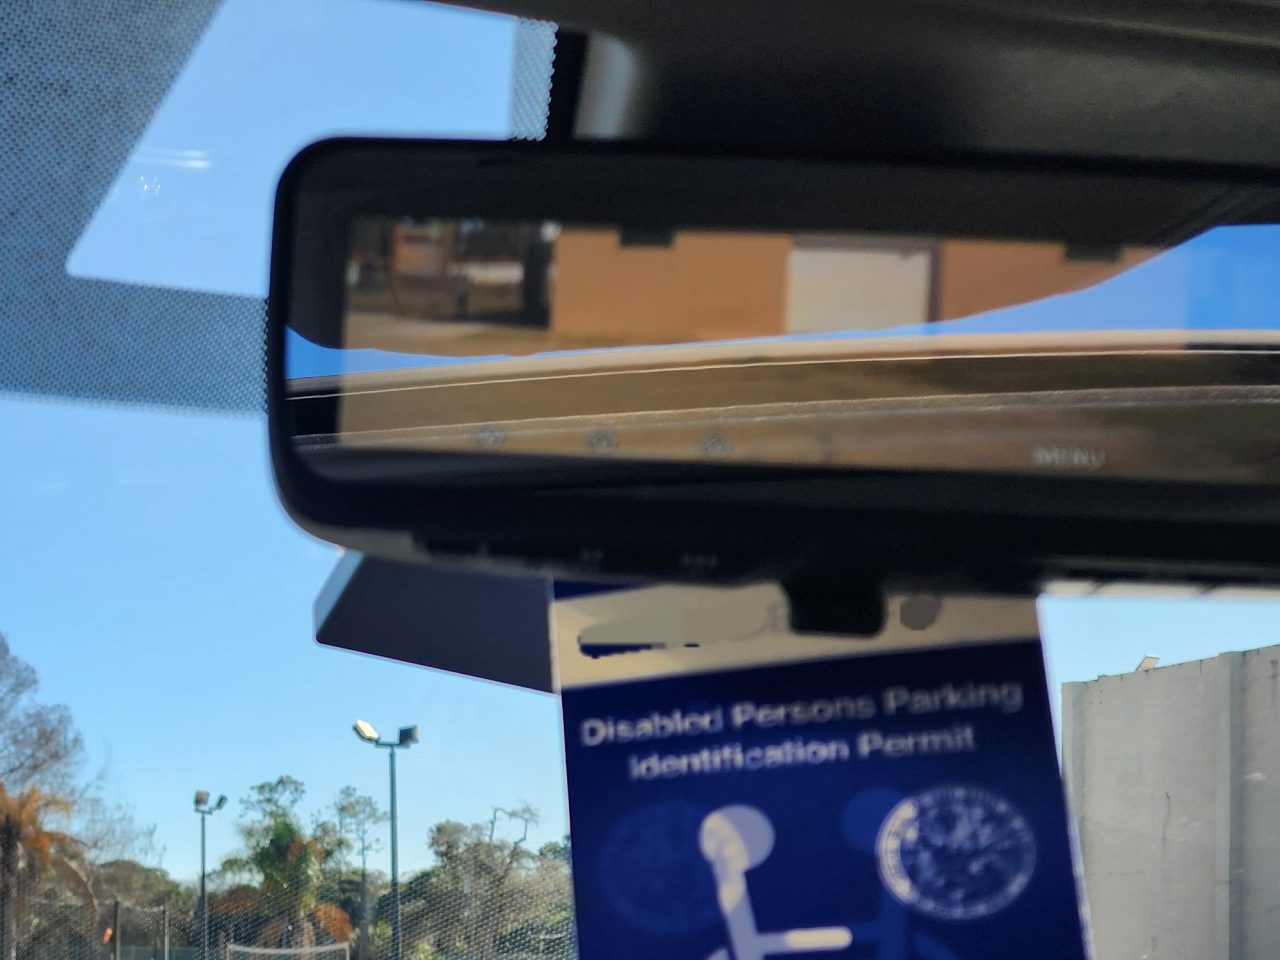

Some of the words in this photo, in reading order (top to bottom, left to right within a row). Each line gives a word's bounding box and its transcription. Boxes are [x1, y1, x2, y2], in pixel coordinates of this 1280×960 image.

[579, 705, 723, 747] Disabled
[731, 694, 876, 731] Persons
[882, 681, 1024, 718] Parking
[628, 738, 850, 782] Identification
[857, 723, 977, 760] Permit
